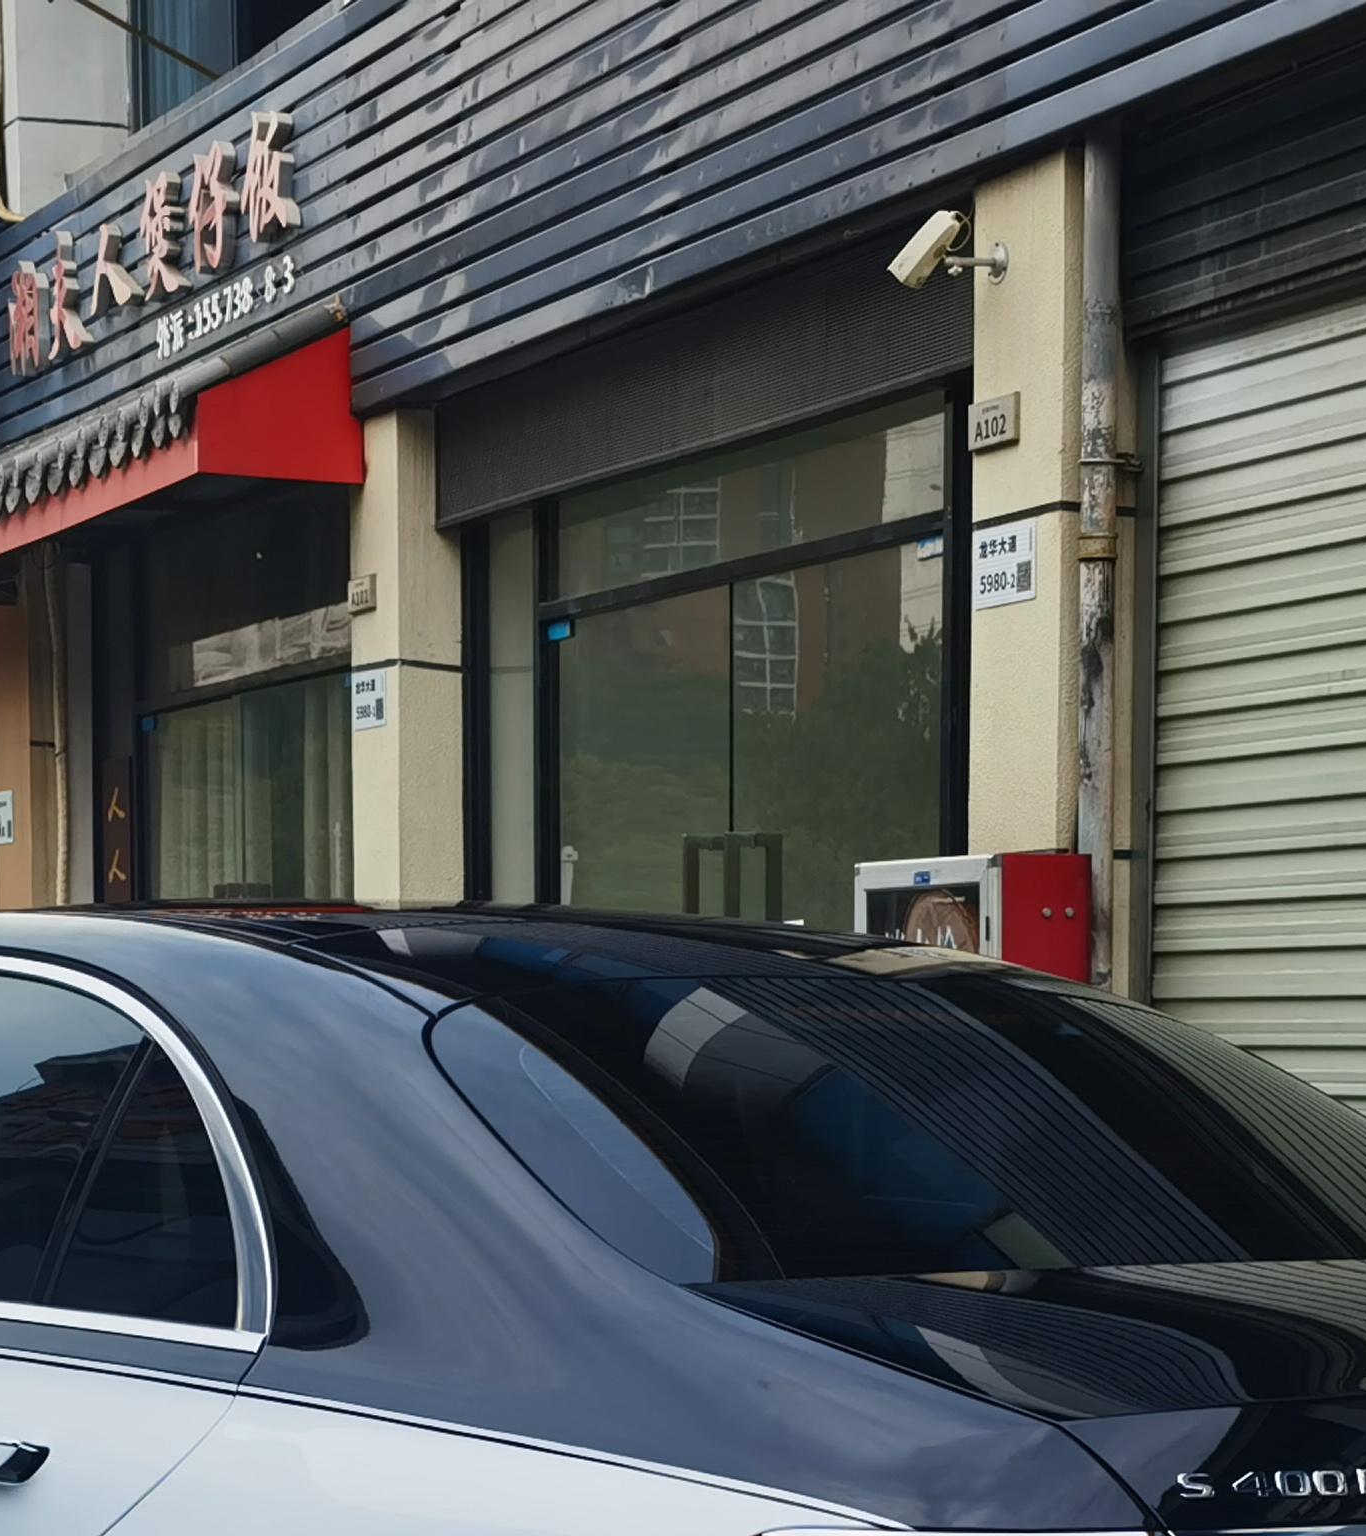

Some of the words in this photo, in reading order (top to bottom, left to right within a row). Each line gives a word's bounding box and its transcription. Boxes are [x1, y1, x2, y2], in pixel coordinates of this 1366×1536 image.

[974, 413, 1007, 443] A102
[979, 535, 1017, 559] 龙华大道
[979, 571, 1016, 594] 5980-2
[1176, 1473, 1215, 1498] S
